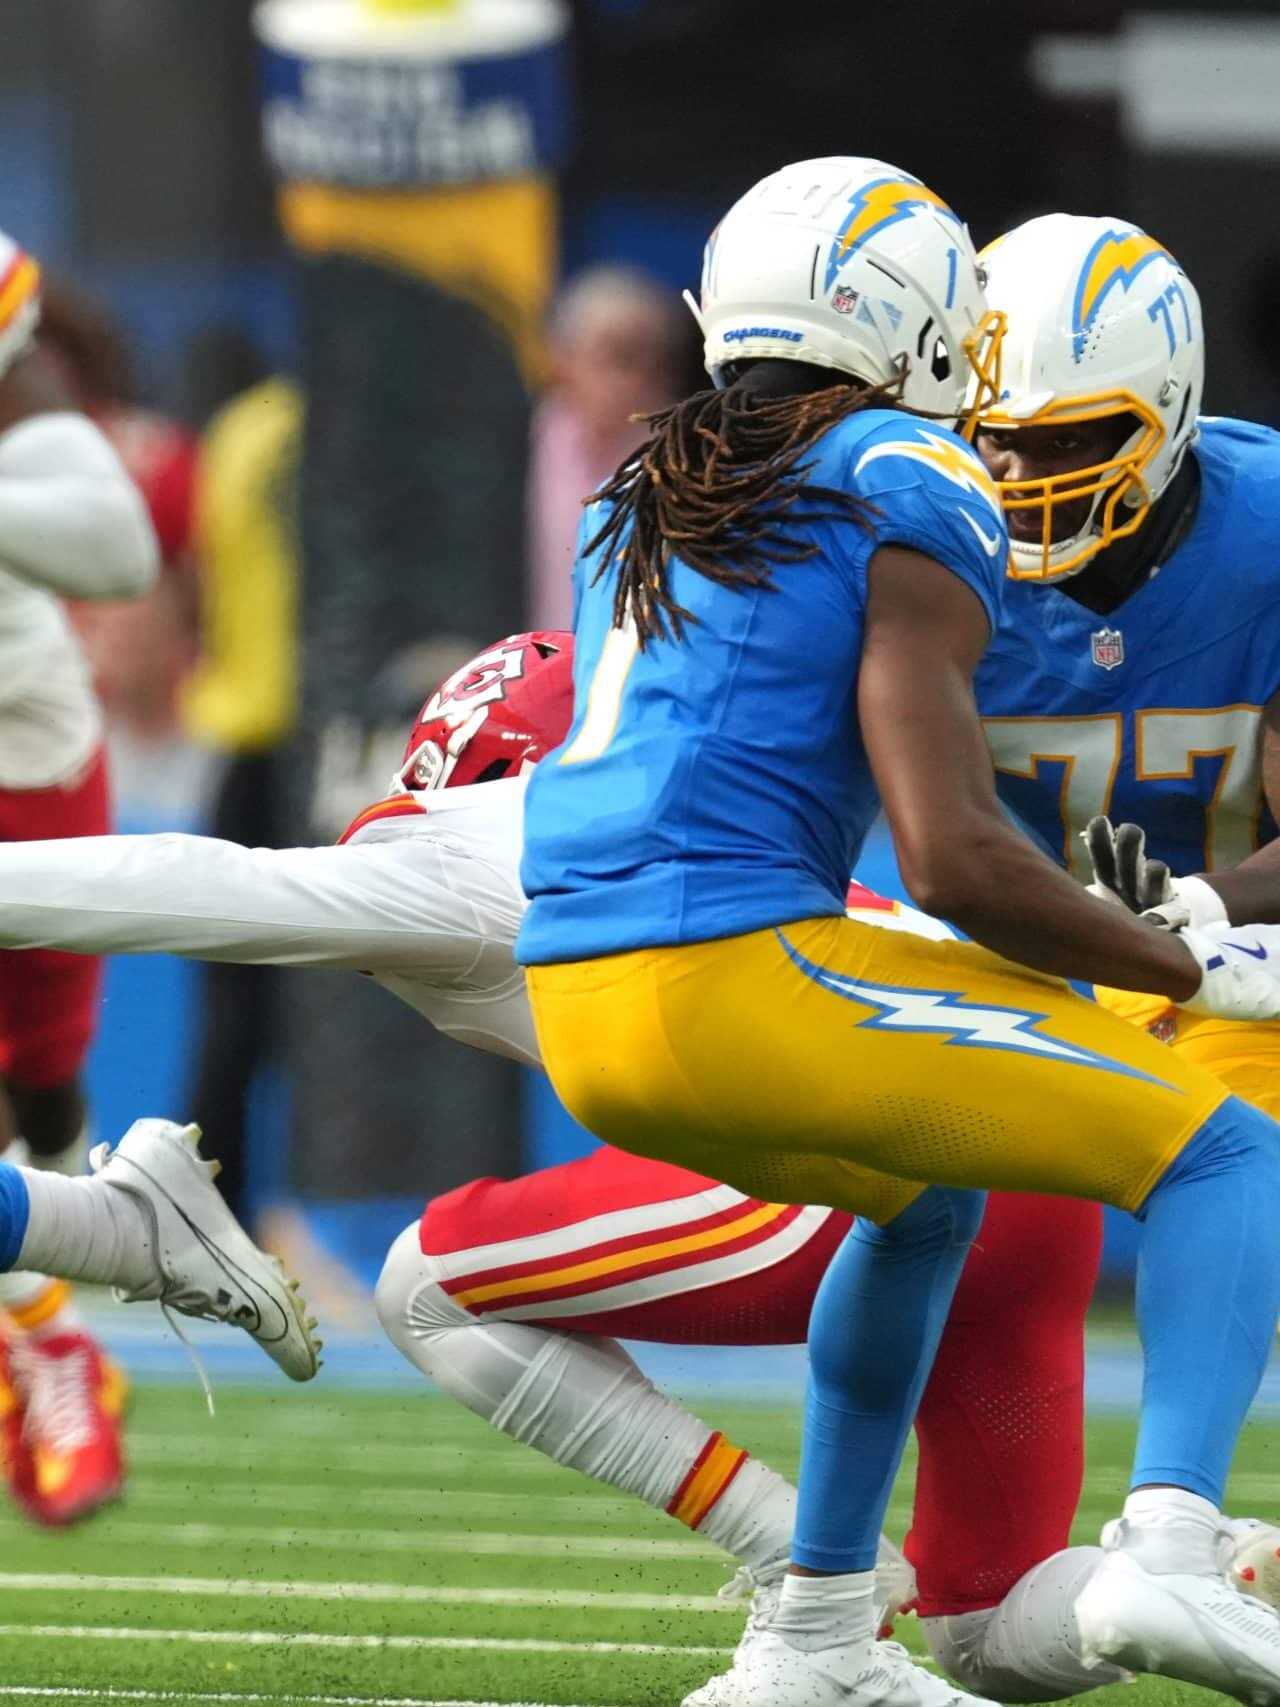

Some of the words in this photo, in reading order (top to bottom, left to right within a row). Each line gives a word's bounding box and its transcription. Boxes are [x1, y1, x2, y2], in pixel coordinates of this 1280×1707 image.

[944, 247, 958, 309] 1
[723, 327, 805, 344] CHARGERS
[1147, 280, 1192, 360] 77
[1096, 646, 1120, 662] NFL
[982, 703, 1263, 884] 77
